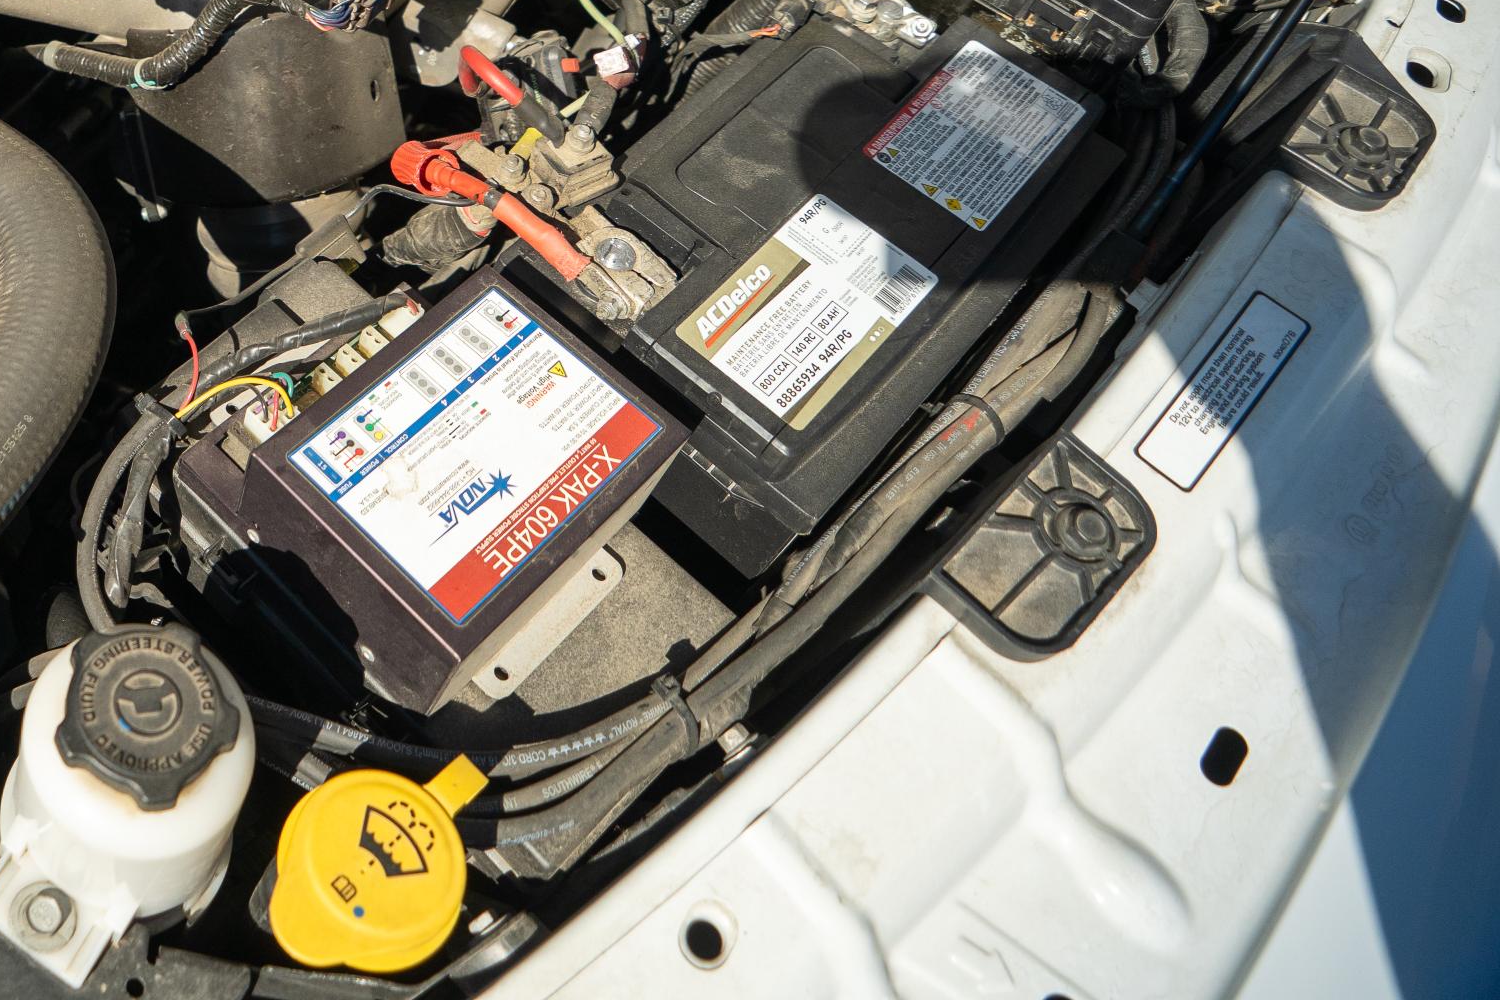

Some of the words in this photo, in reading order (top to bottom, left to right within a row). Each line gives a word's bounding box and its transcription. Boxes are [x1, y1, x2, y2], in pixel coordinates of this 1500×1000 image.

[797, 197, 829, 225] 94R/PG
[695, 264, 772, 339] ACDelco
[725, 321, 771, 366] MAINTENANCE
[768, 305, 786, 323] FREE
[784, 279, 813, 307] BATTERY
[731, 344, 760, 372] BATTERIE
[757, 330, 774, 346] SANS
[772, 301, 802, 331] ENTRETIEN
[761, 336, 780, 354] LIBRE
[776, 328, 788, 338] DE
[784, 287, 828, 330] MANTENIMIENTO
[513, 347, 525, 358] void
[521, 331, 543, 349] Warranty
[759, 373, 776, 390] 800
[772, 359, 790, 376] CCA
[791, 341, 807, 356] 140
[803, 332, 816, 344] RC
[817, 318, 830, 330] 80
[534, 371, 552, 387] High
[576, 375, 597, 393] OUTPUT
[775, 362, 821, 408] 88865934
[817, 328, 854, 364] 94R/PG
[1169, 410, 1181, 423] Do
[1177, 399, 1190, 413] not
[1186, 382, 1205, 402] apply
[1199, 365, 1216, 384] more
[1212, 350, 1228, 367] than
[1223, 327, 1245, 352] nominal
[1178, 411, 1193, 427] 12V
[1189, 404, 1199, 413] to
[1195, 374, 1222, 405] electrical
[1217, 352, 1240, 378] system
[1233, 333, 1254, 356] during
[439, 398, 448, 406] 4
[514, 383, 539, 405] Voltage
[523, 380, 556, 409] WARNING!
[1192, 397, 1219, 428] charging
[1214, 390, 1224, 399] or
[1219, 373, 1238, 393] jump
[1199, 410, 1221, 436] Engine
[1216, 398, 1230, 413] and
[1225, 373, 1250, 402] starting
[1244, 351, 1267, 376] system
[1217, 406, 1237, 429] failure
[1232, 388, 1250, 408] could
[382, 432, 409, 455] CONTROL
[358, 457, 380, 476] POWER
[548, 444, 622, 514] X-PAK
[336, 479, 353, 495] FUSE
[526, 473, 559, 504] PRE-EMPTION
[508, 501, 529, 521] STROBE
[473, 534, 494, 554] SUPPLY
[481, 502, 561, 577] 604PE
[490, 518, 511, 538] POWER
[93, 636, 175, 671] STEERING
[80, 672, 97, 722] FLUID
[177, 653, 215, 715] POWER
[185, 723, 212, 756] USE
[517, 747, 546, 764] CORD
